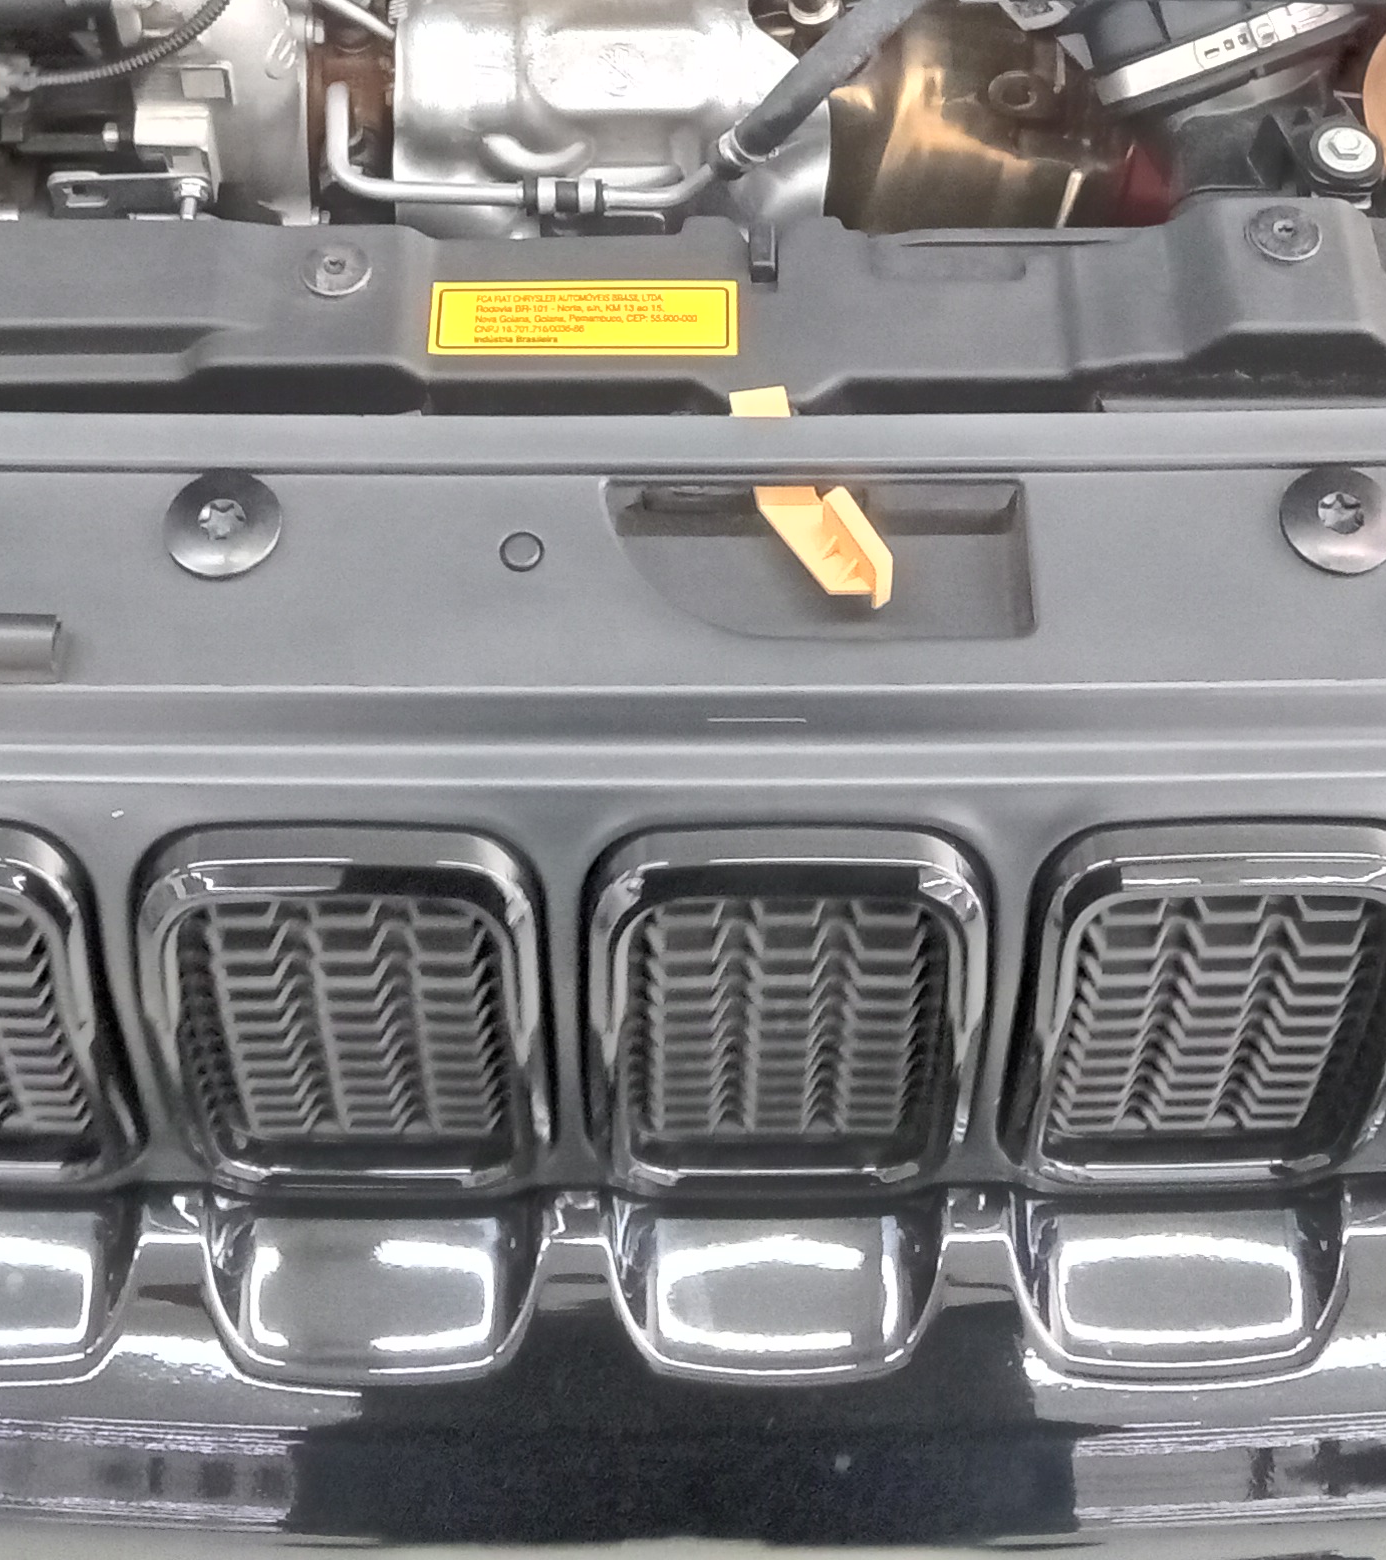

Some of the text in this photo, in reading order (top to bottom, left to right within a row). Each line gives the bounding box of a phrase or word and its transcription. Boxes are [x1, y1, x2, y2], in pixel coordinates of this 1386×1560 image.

[515, 305, 548, 313] BR-101
[605, 304, 621, 312] KM
[624, 304, 634, 312] 13
